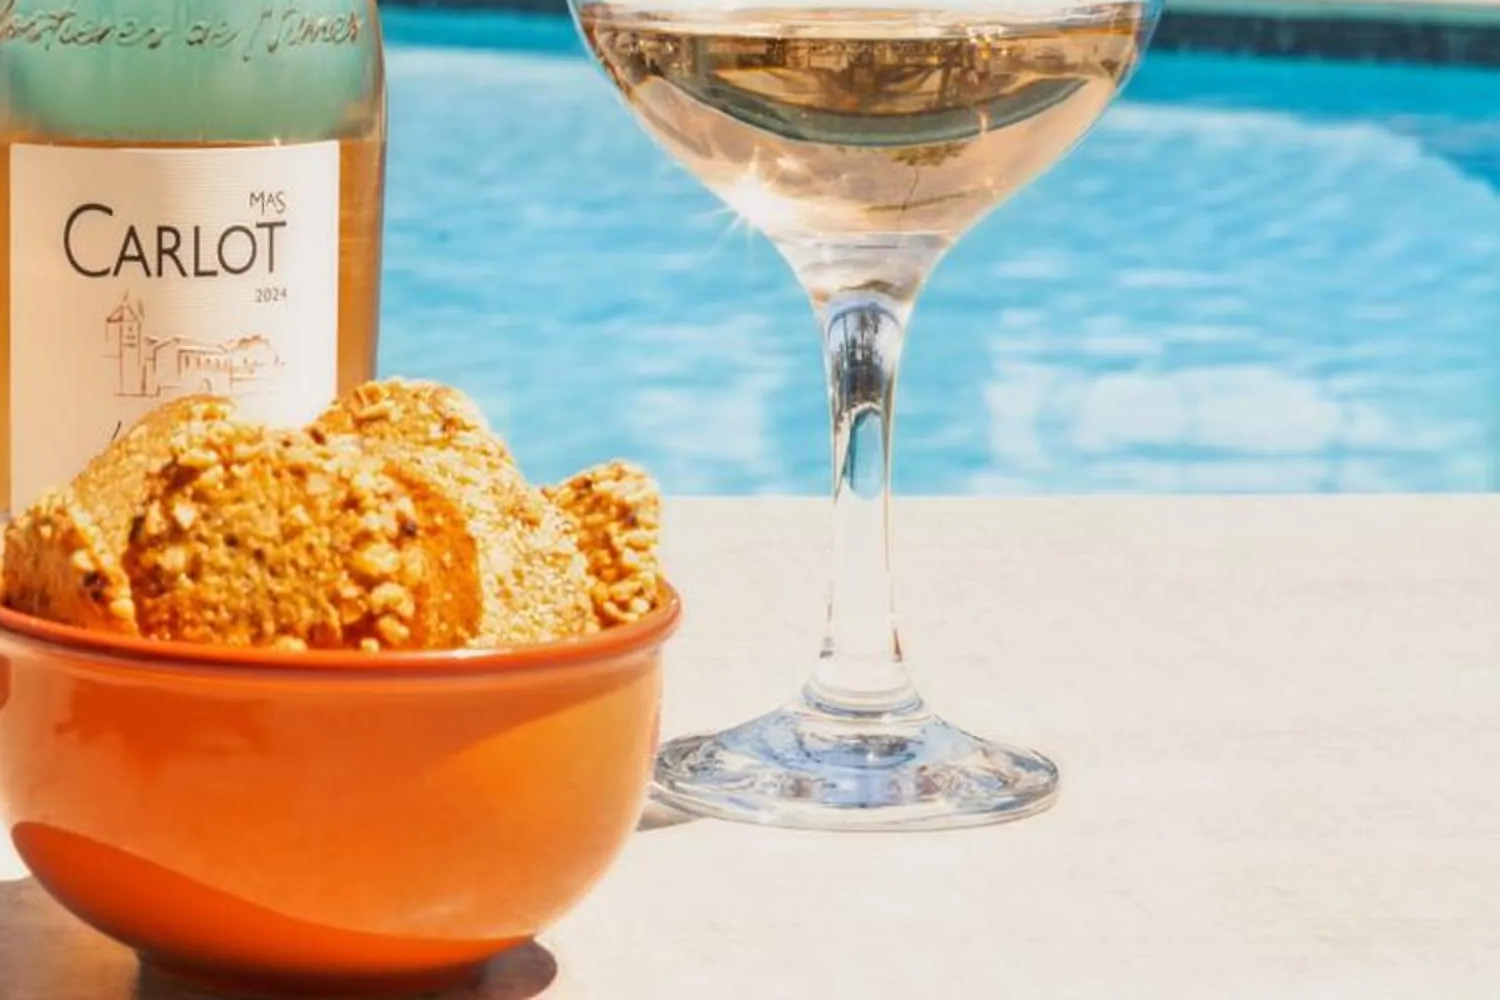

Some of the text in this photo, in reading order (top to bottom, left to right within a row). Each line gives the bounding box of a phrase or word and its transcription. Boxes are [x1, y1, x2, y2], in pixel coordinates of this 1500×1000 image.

[249, 191, 287, 216] MAS
[63, 202, 288, 279] CARLOT
[255, 287, 288, 304] 2024
